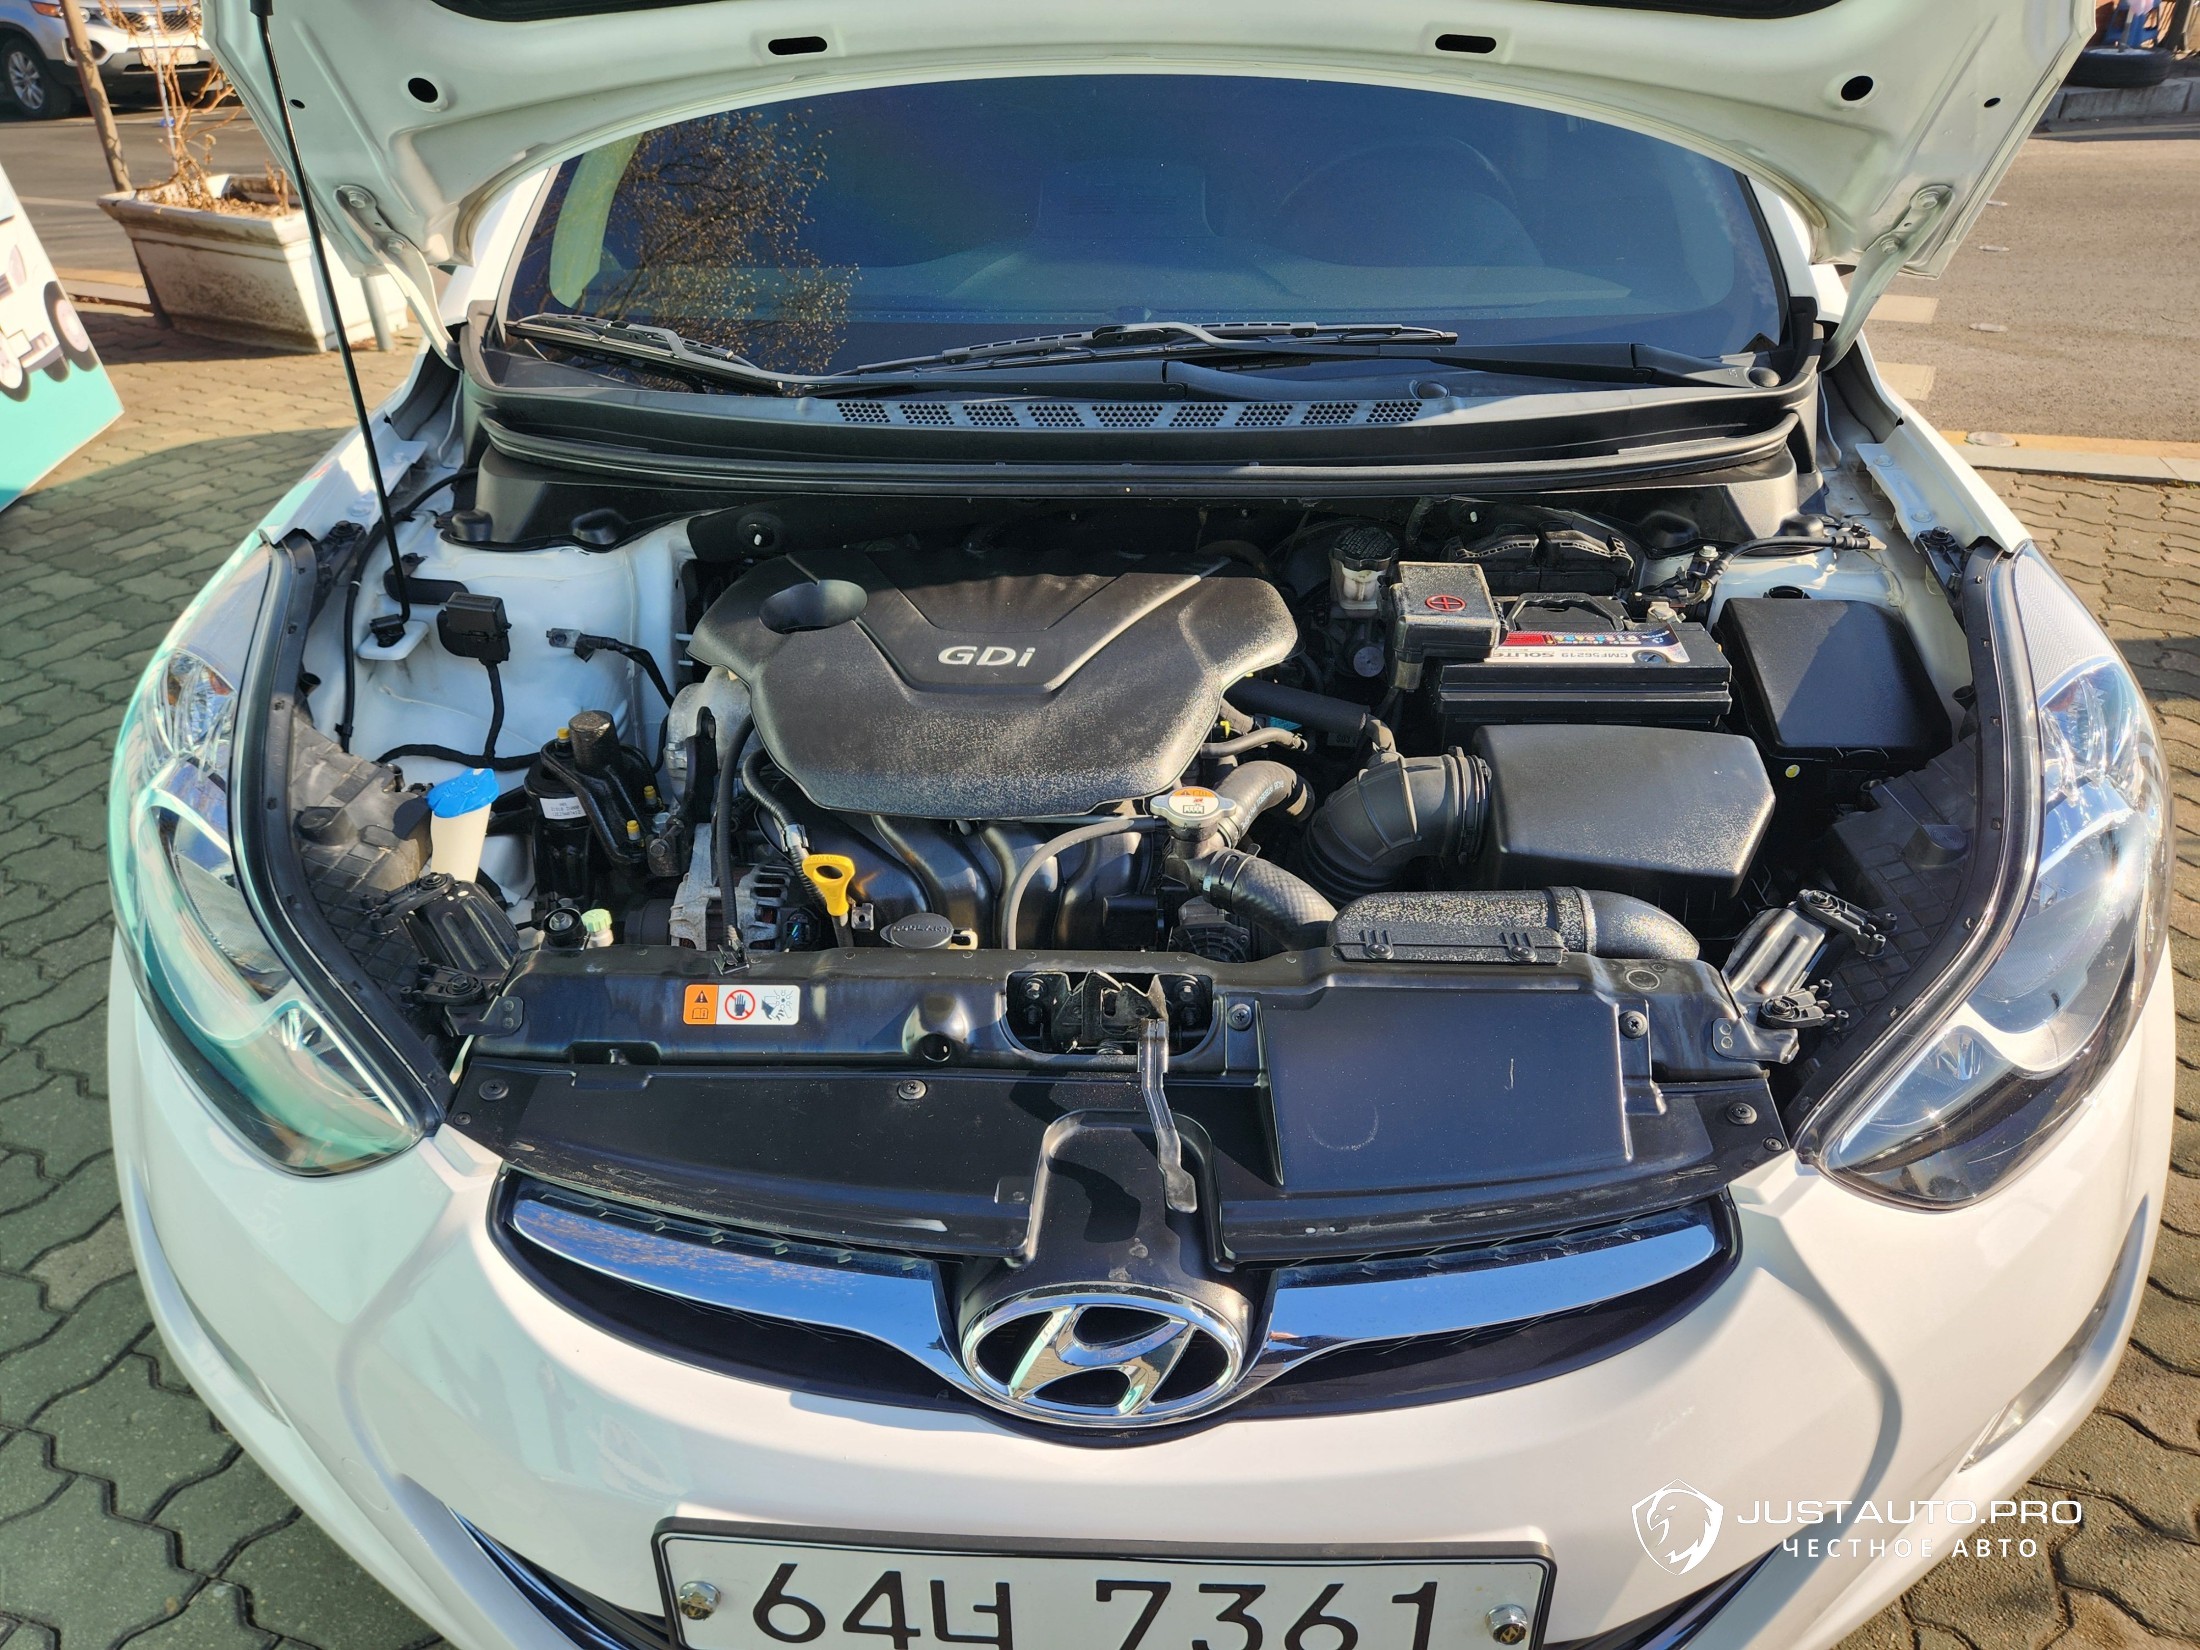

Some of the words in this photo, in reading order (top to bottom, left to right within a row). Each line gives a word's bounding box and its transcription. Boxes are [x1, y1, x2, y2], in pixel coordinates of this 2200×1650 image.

[937, 645, 1036, 667] GDi
[752, 1562, 1014, 1650] 64너
[1096, 1579, 1438, 1650] 7361
